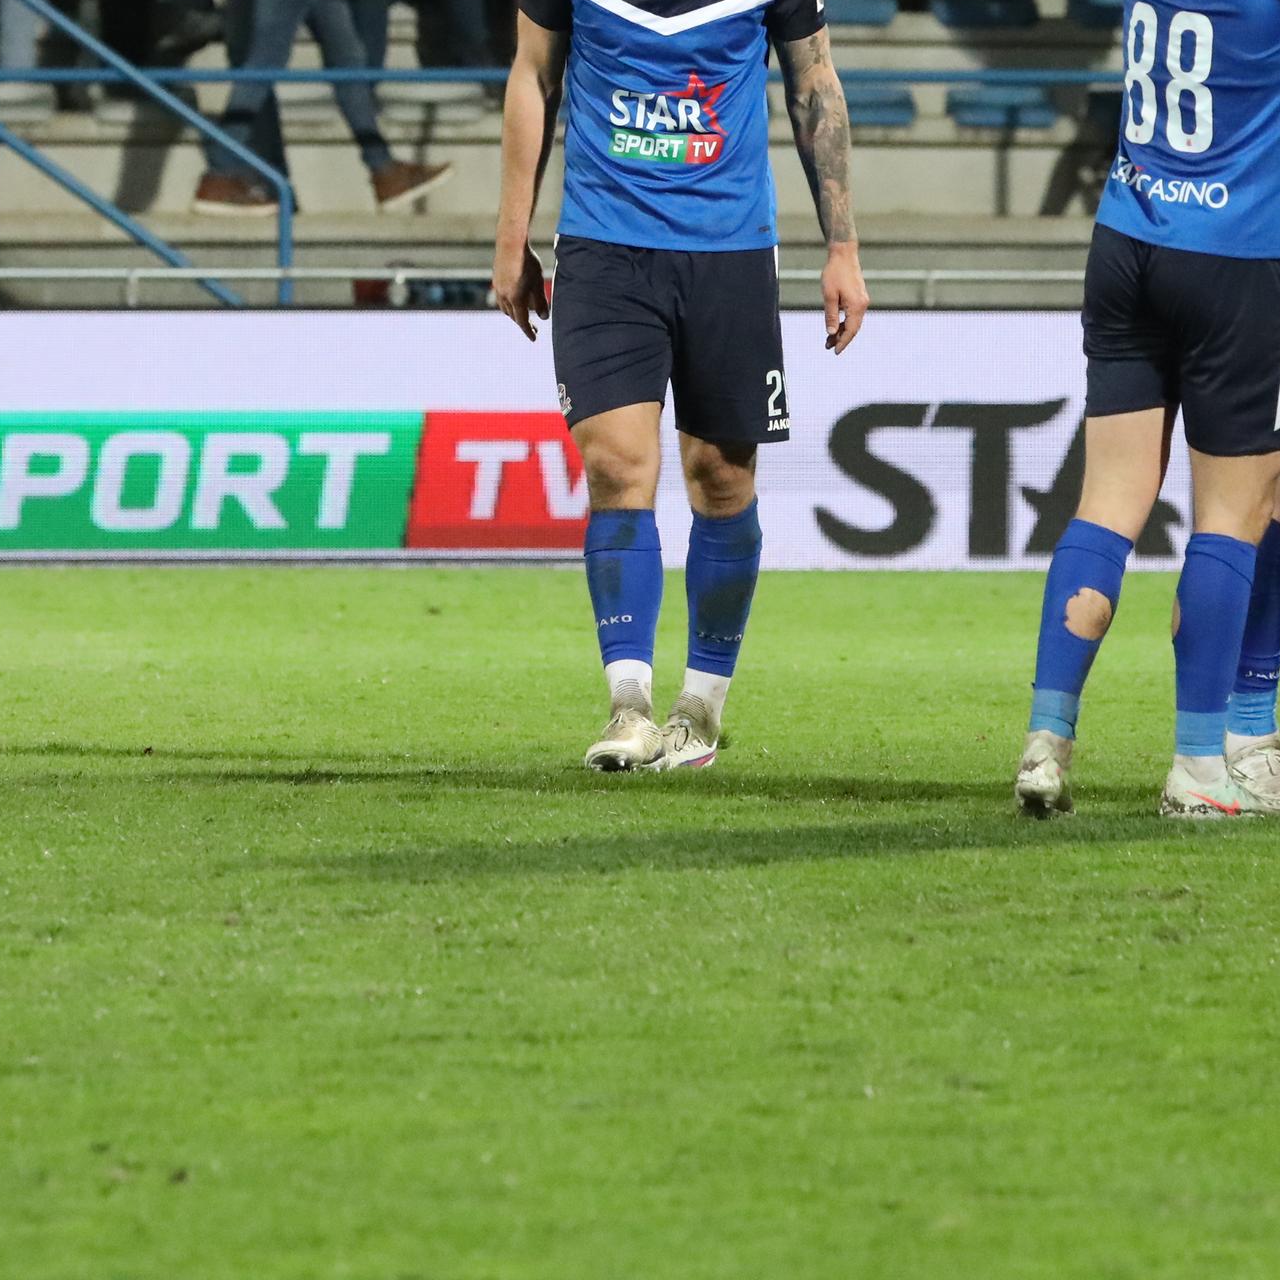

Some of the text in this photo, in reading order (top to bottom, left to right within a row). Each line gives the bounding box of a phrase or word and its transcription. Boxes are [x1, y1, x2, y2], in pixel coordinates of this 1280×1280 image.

[1124, 2, 1214, 153] 88
[609, 89, 710, 133] STAR
[613, 133, 718, 158] SPORT TV
[455, 438, 591, 521] TV
